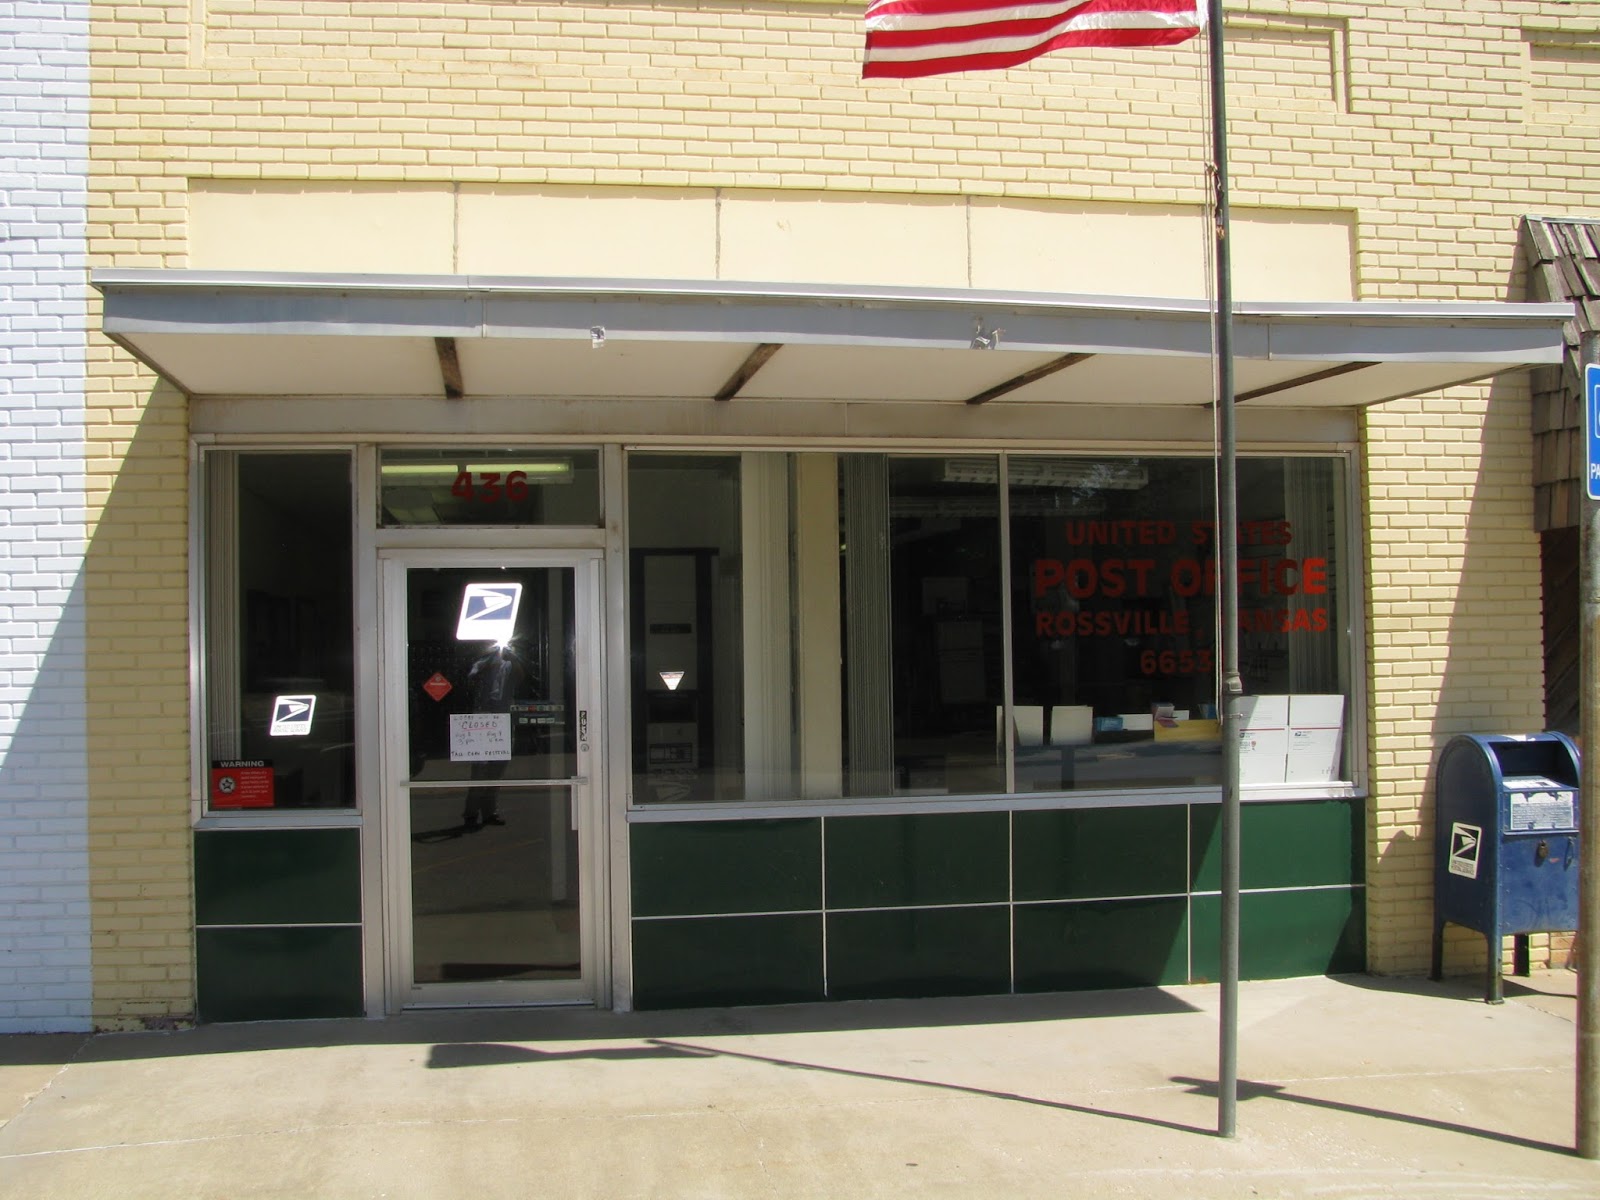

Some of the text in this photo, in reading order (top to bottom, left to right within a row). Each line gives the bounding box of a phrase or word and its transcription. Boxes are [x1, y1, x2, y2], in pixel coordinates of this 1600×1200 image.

[451, 470, 529, 502] 436
[1065, 520, 1177, 546] UNITED
[1034, 558, 1156, 599] POST
[1225, 608, 1328, 633] ANSAS
[1139, 649, 1221, 675] 6653
[461, 721, 498, 730] CLOSED
